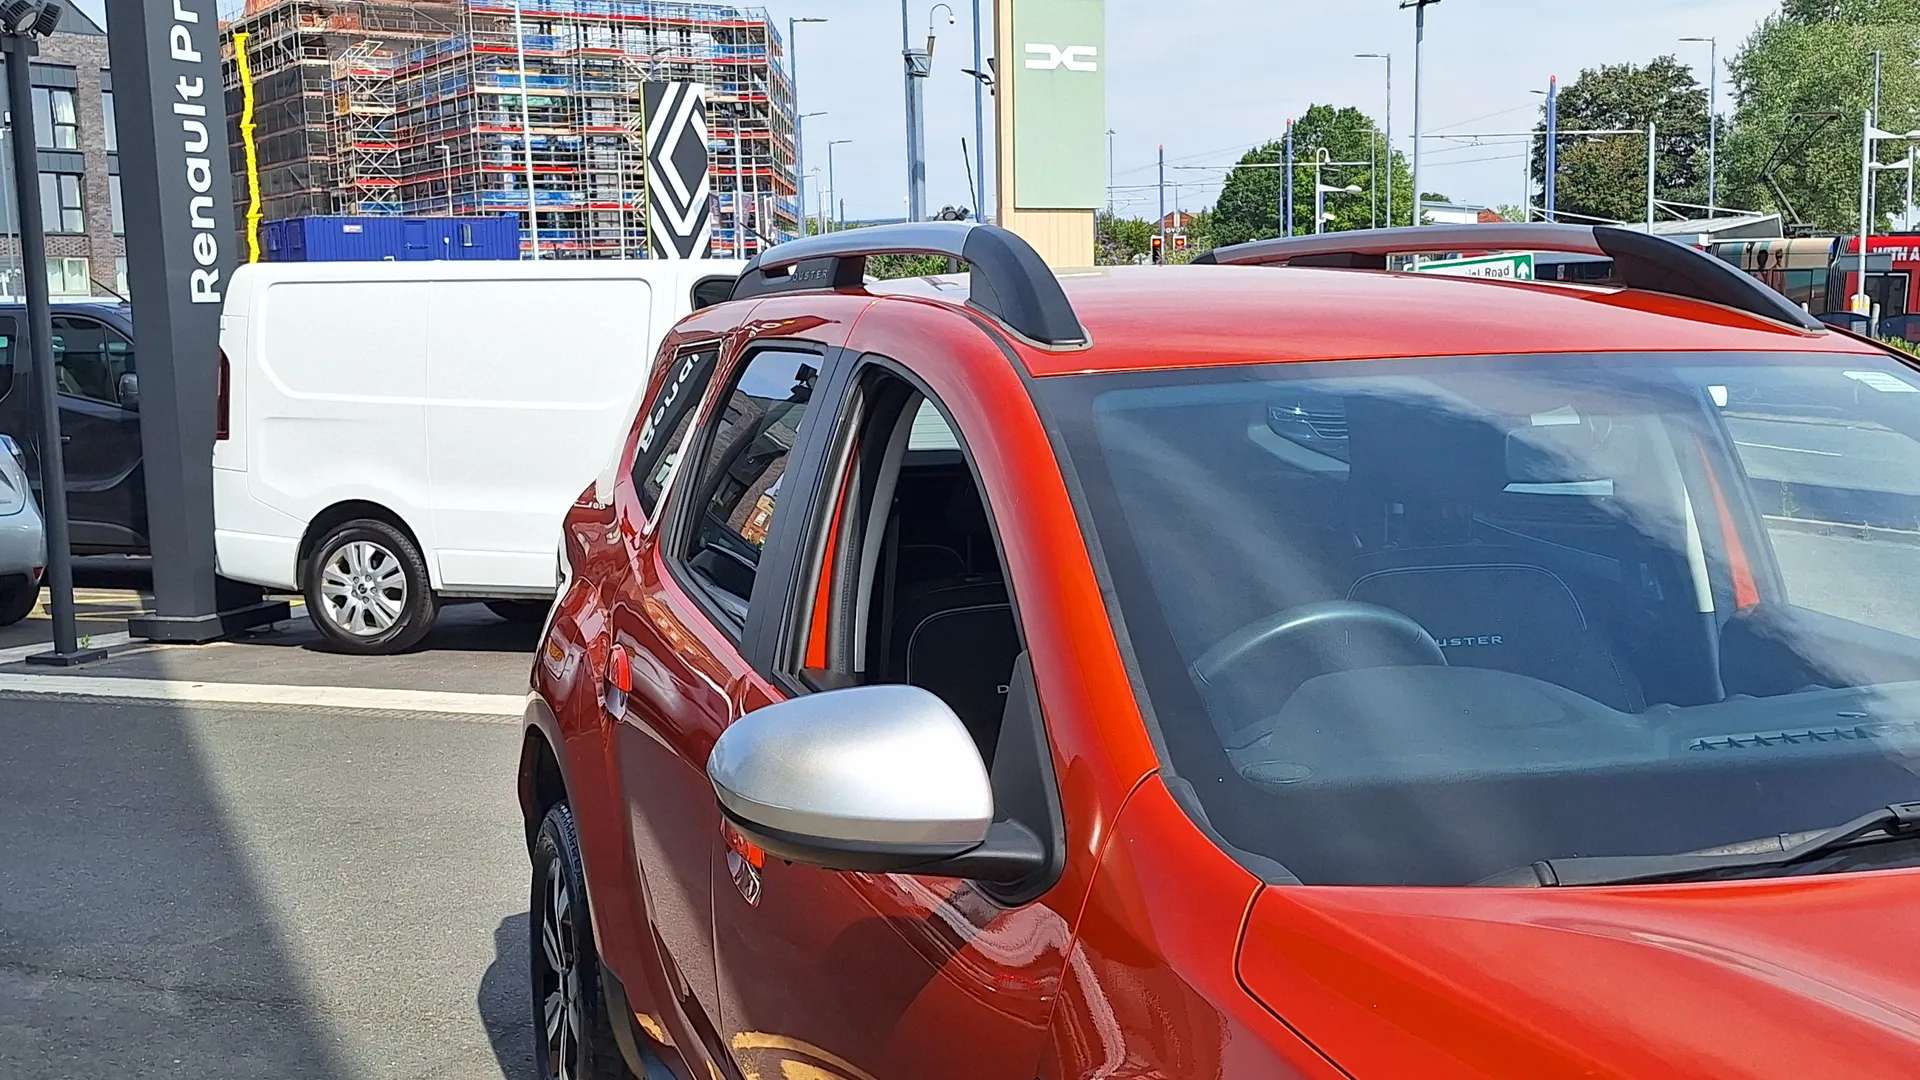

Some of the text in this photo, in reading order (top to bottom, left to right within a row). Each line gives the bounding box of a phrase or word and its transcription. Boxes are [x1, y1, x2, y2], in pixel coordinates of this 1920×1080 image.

[173, 75, 222, 303] Renault
[792, 269, 829, 281] DUSTER
[1484, 265, 1510, 278] Road
[1435, 635, 1503, 647] USTER
